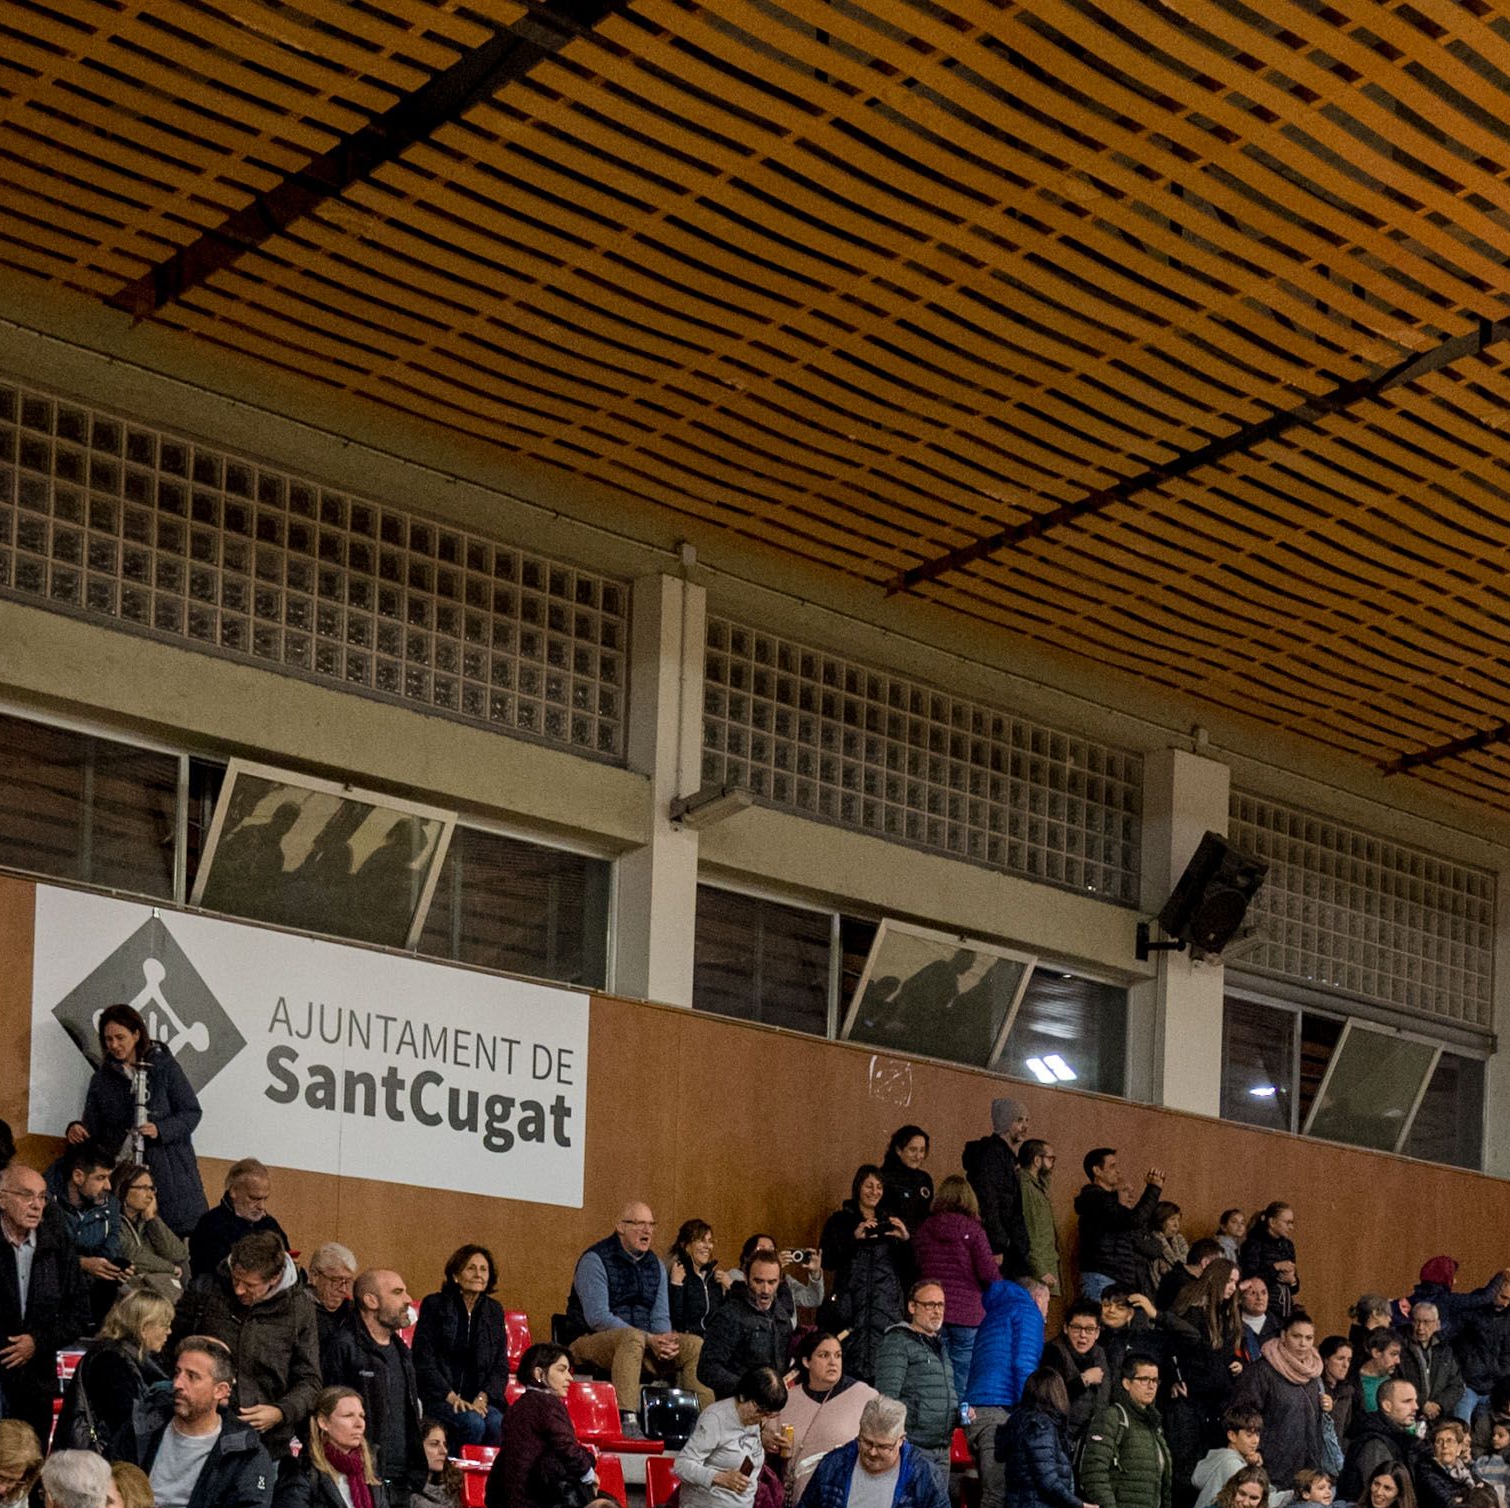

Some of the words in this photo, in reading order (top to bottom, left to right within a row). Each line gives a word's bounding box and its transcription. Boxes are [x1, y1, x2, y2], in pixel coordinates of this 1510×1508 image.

[267, 996, 521, 1075] AJUNTAMENT
[532, 1043, 574, 1085] DE
[264, 1044, 572, 1154] SantCugat
